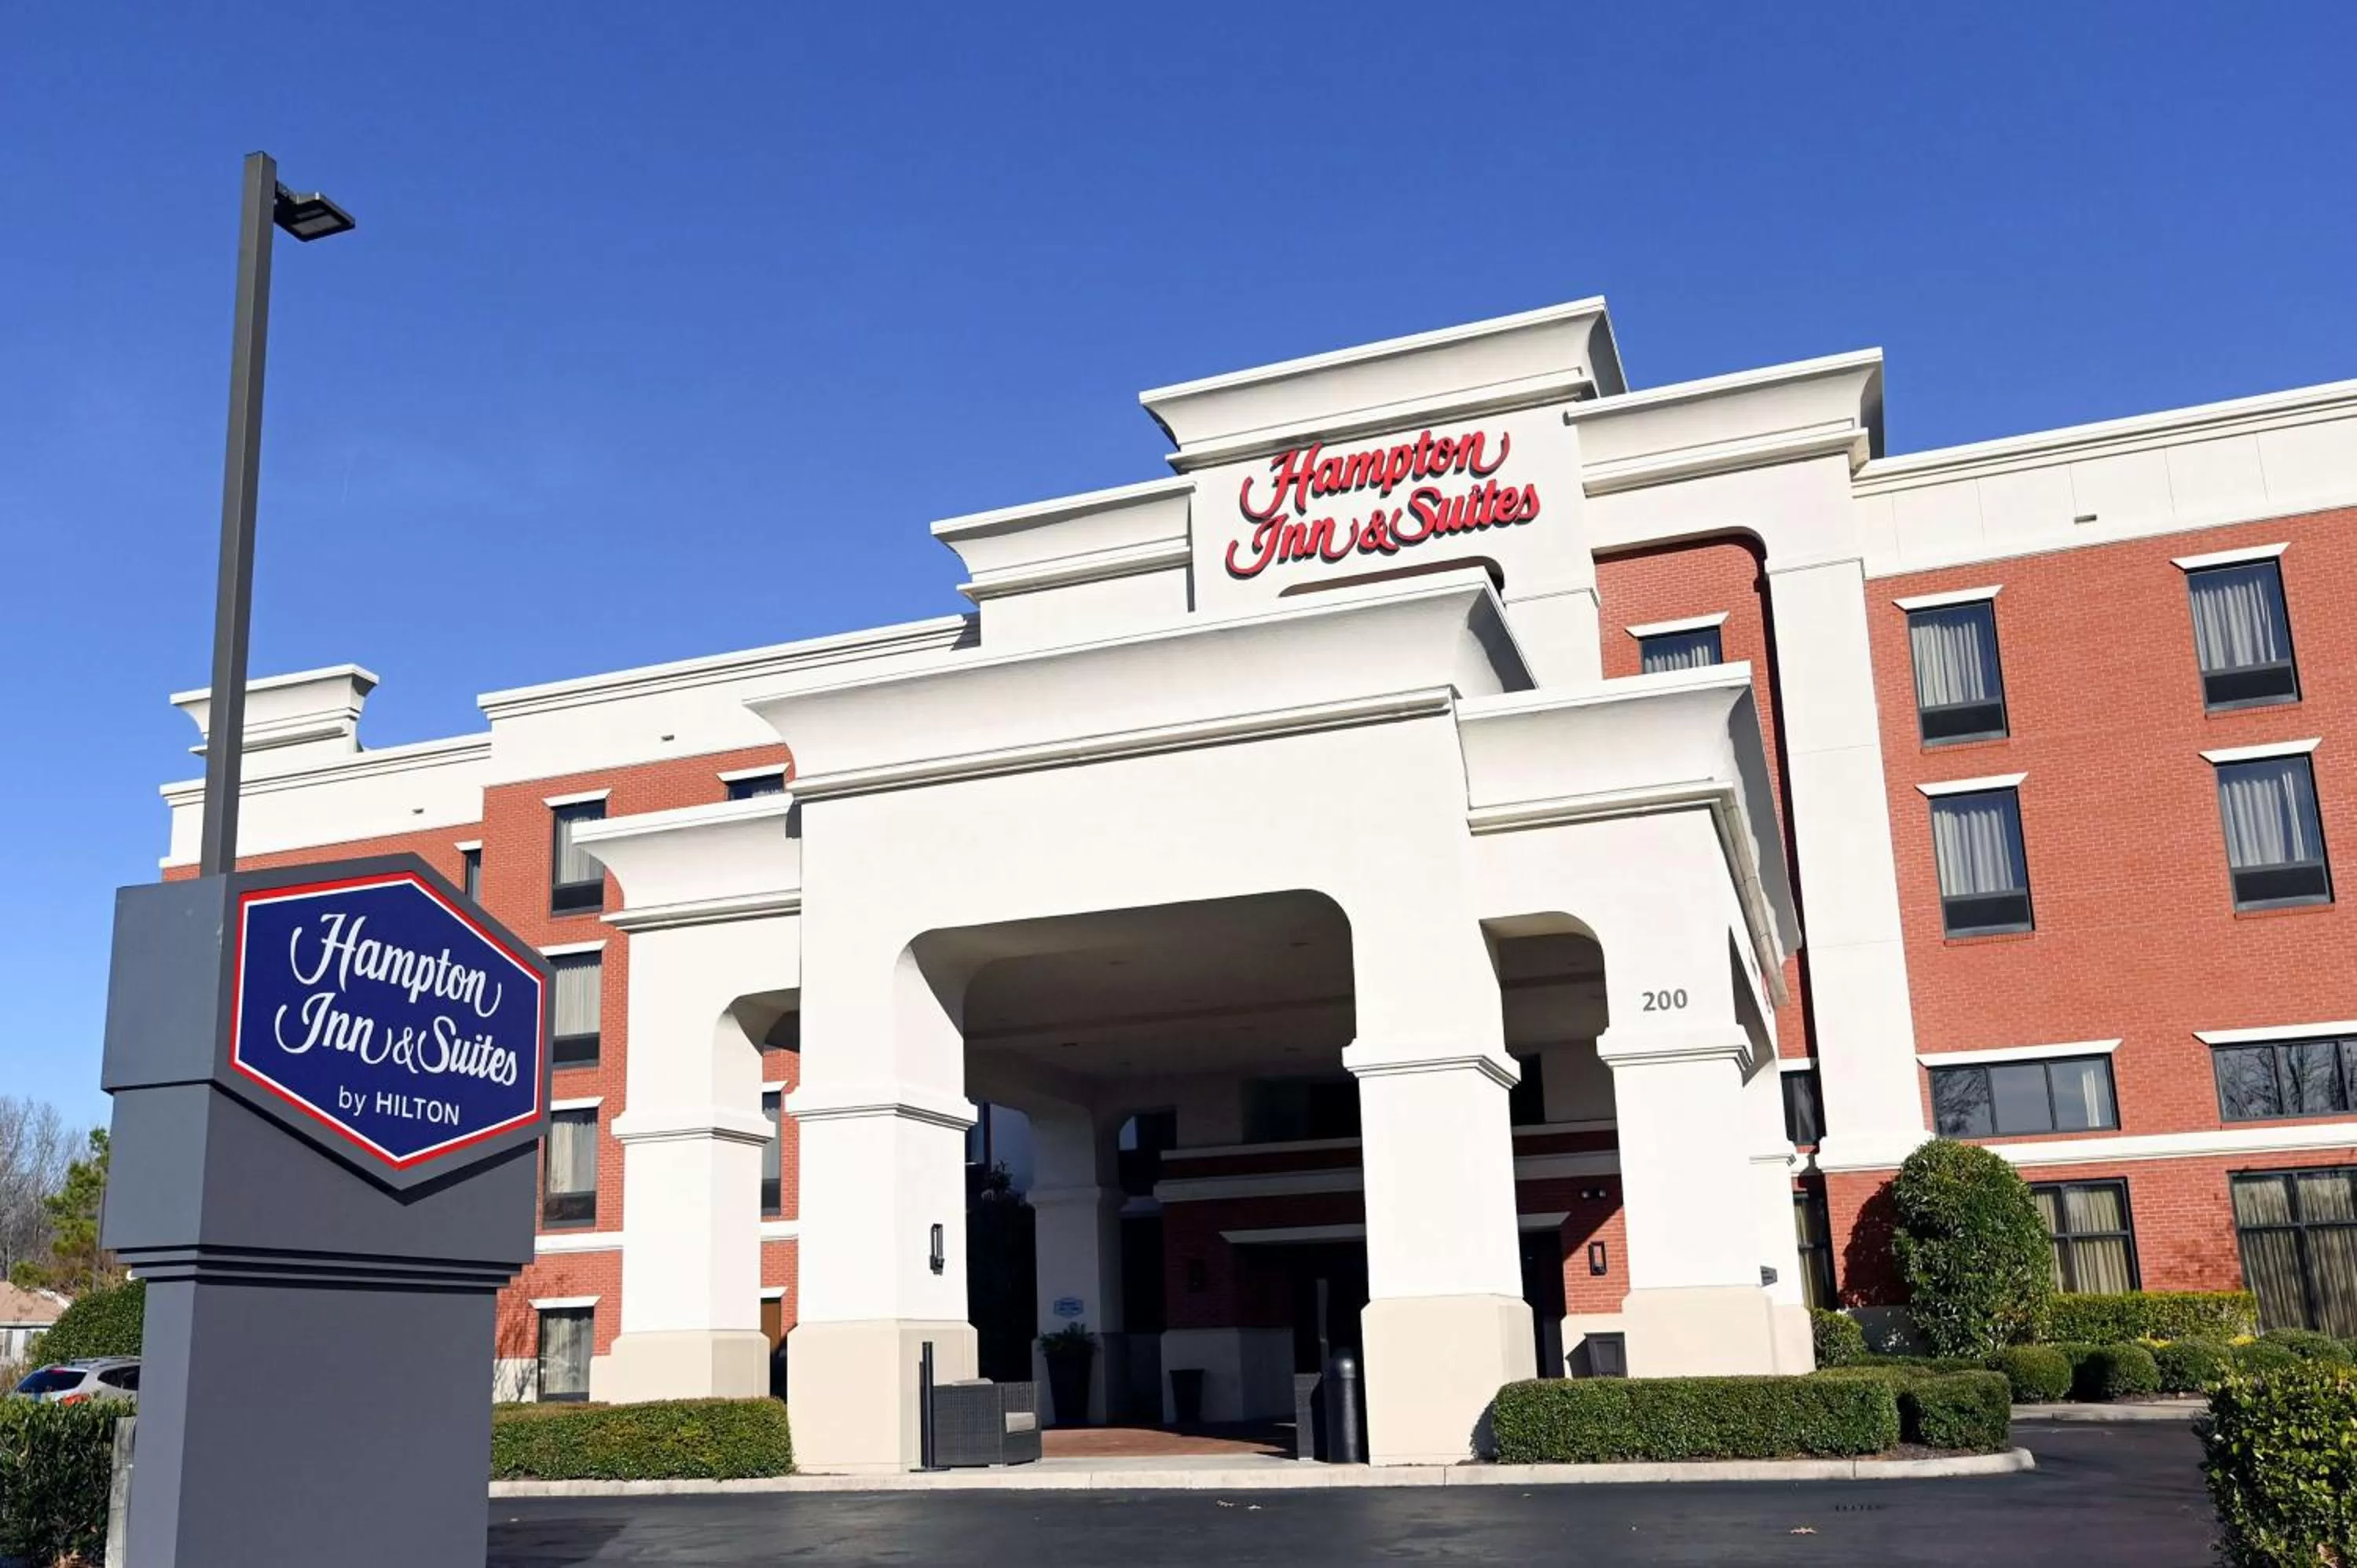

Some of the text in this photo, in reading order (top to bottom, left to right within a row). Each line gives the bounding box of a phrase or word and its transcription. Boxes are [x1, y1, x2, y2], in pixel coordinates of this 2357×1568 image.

[1240, 430, 1511, 524] Hampton
[1225, 478, 1541, 580] Inn & Suites
[290, 914, 502, 1017] Hampton
[1642, 988, 1688, 1012] 200
[274, 991, 518, 1086] Inn & Suites
[339, 1086, 460, 1126] by HILTON
